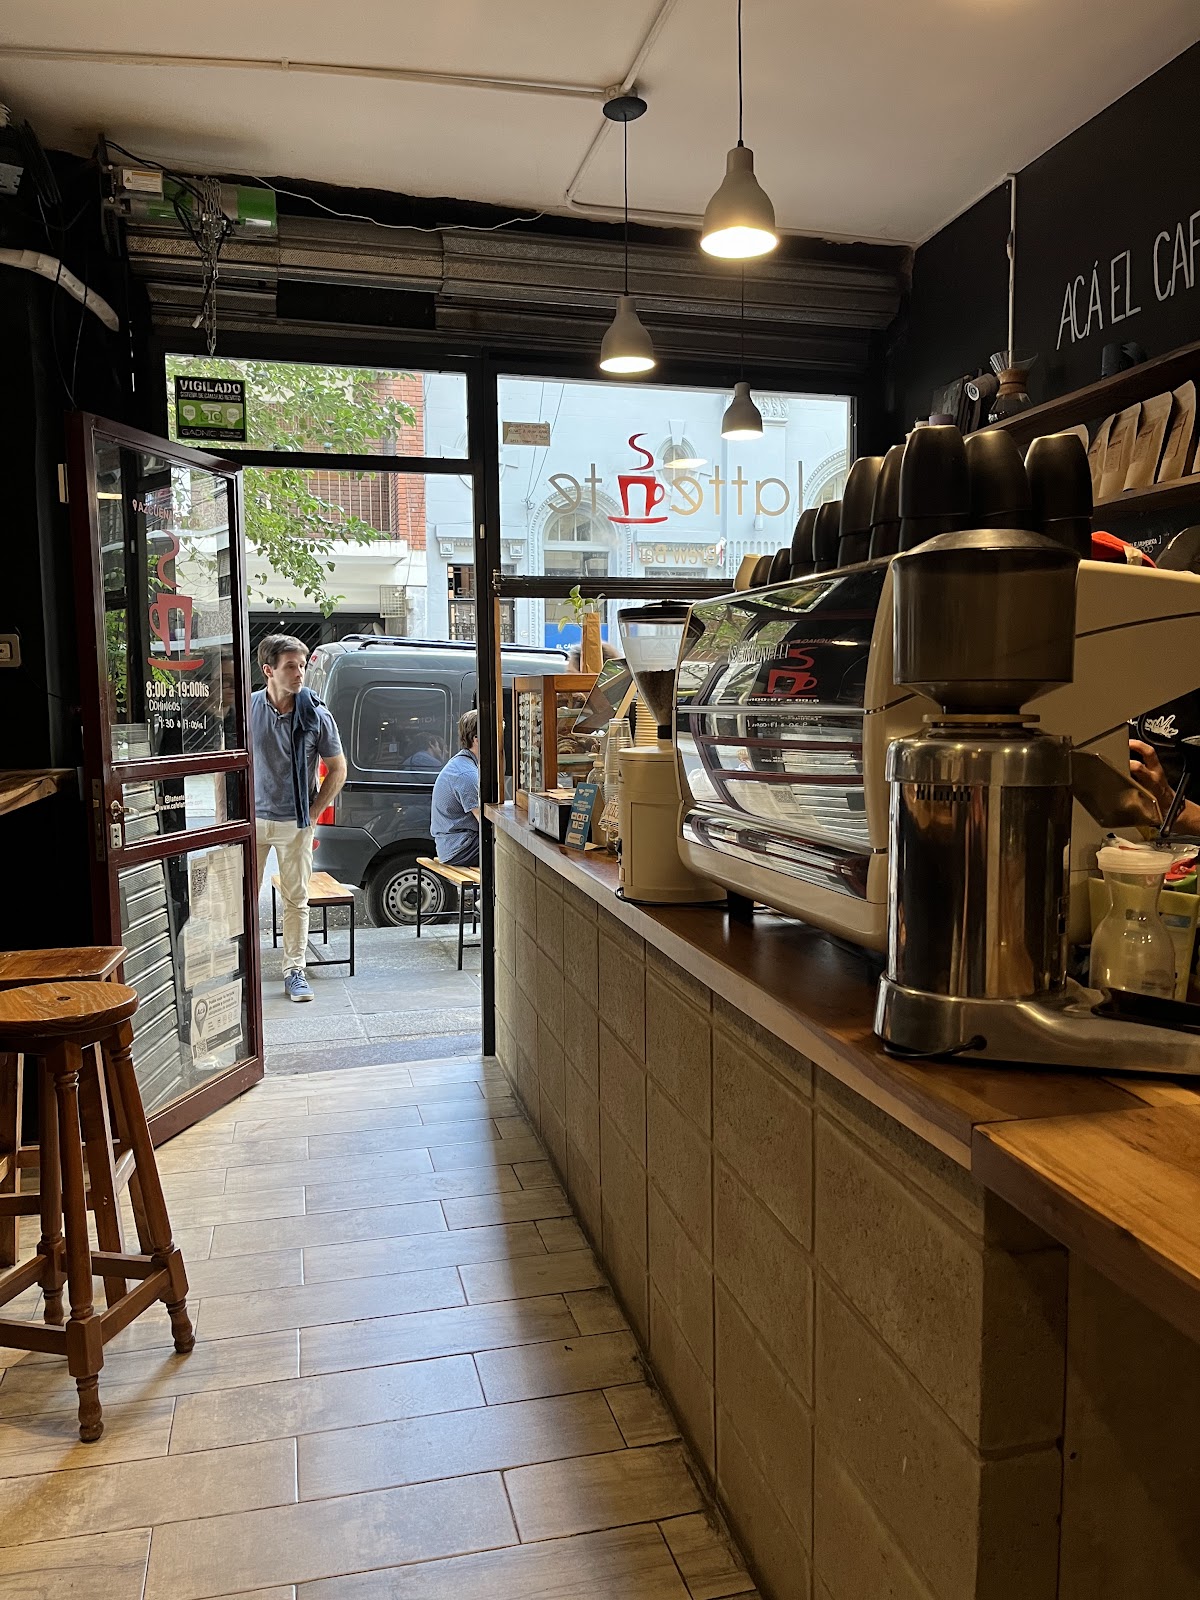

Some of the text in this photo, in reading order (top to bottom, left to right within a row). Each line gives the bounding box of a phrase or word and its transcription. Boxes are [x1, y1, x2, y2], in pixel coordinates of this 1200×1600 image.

[1056, 260, 1103, 350] ACÁ
[1110, 250, 1141, 324] EL
[179, 380, 241, 395] VIGILADO
[146, 681, 210, 698] 8:00 a 19:00hs
